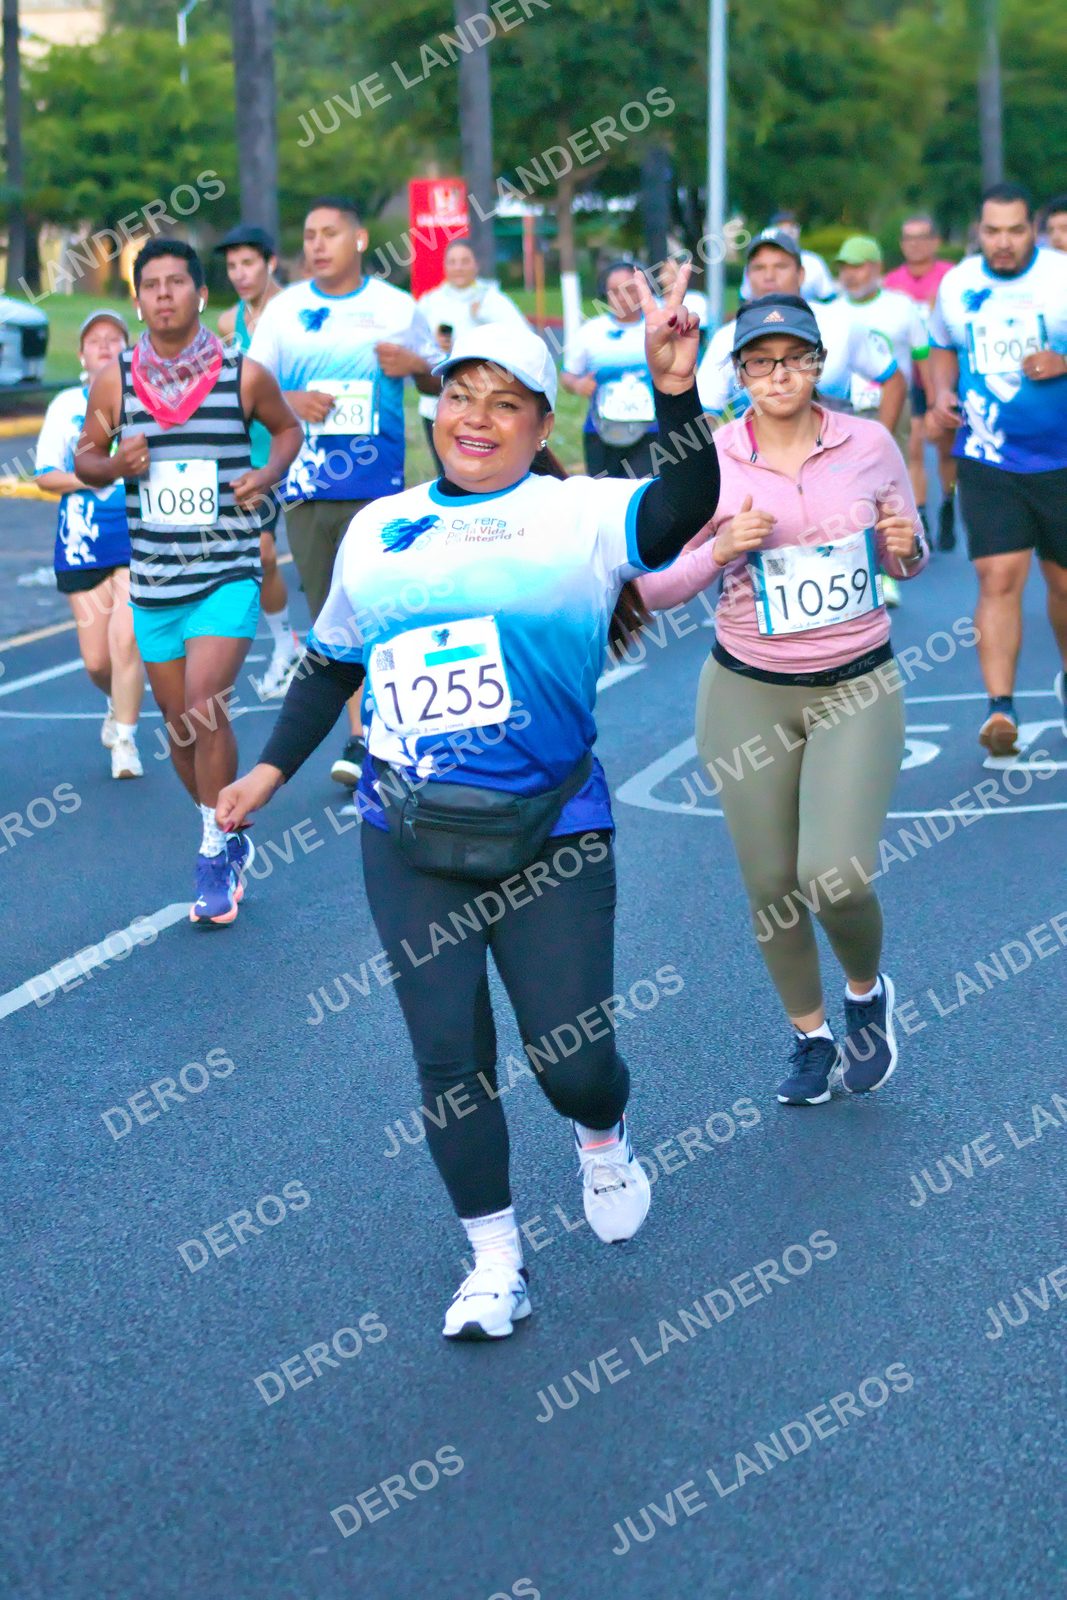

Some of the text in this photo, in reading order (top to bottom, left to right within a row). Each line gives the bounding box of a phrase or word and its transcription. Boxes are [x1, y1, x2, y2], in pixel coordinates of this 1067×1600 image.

[143, 486, 216, 516] 1088
[774, 567, 869, 621] 1059
[383, 662, 505, 725] 1255
